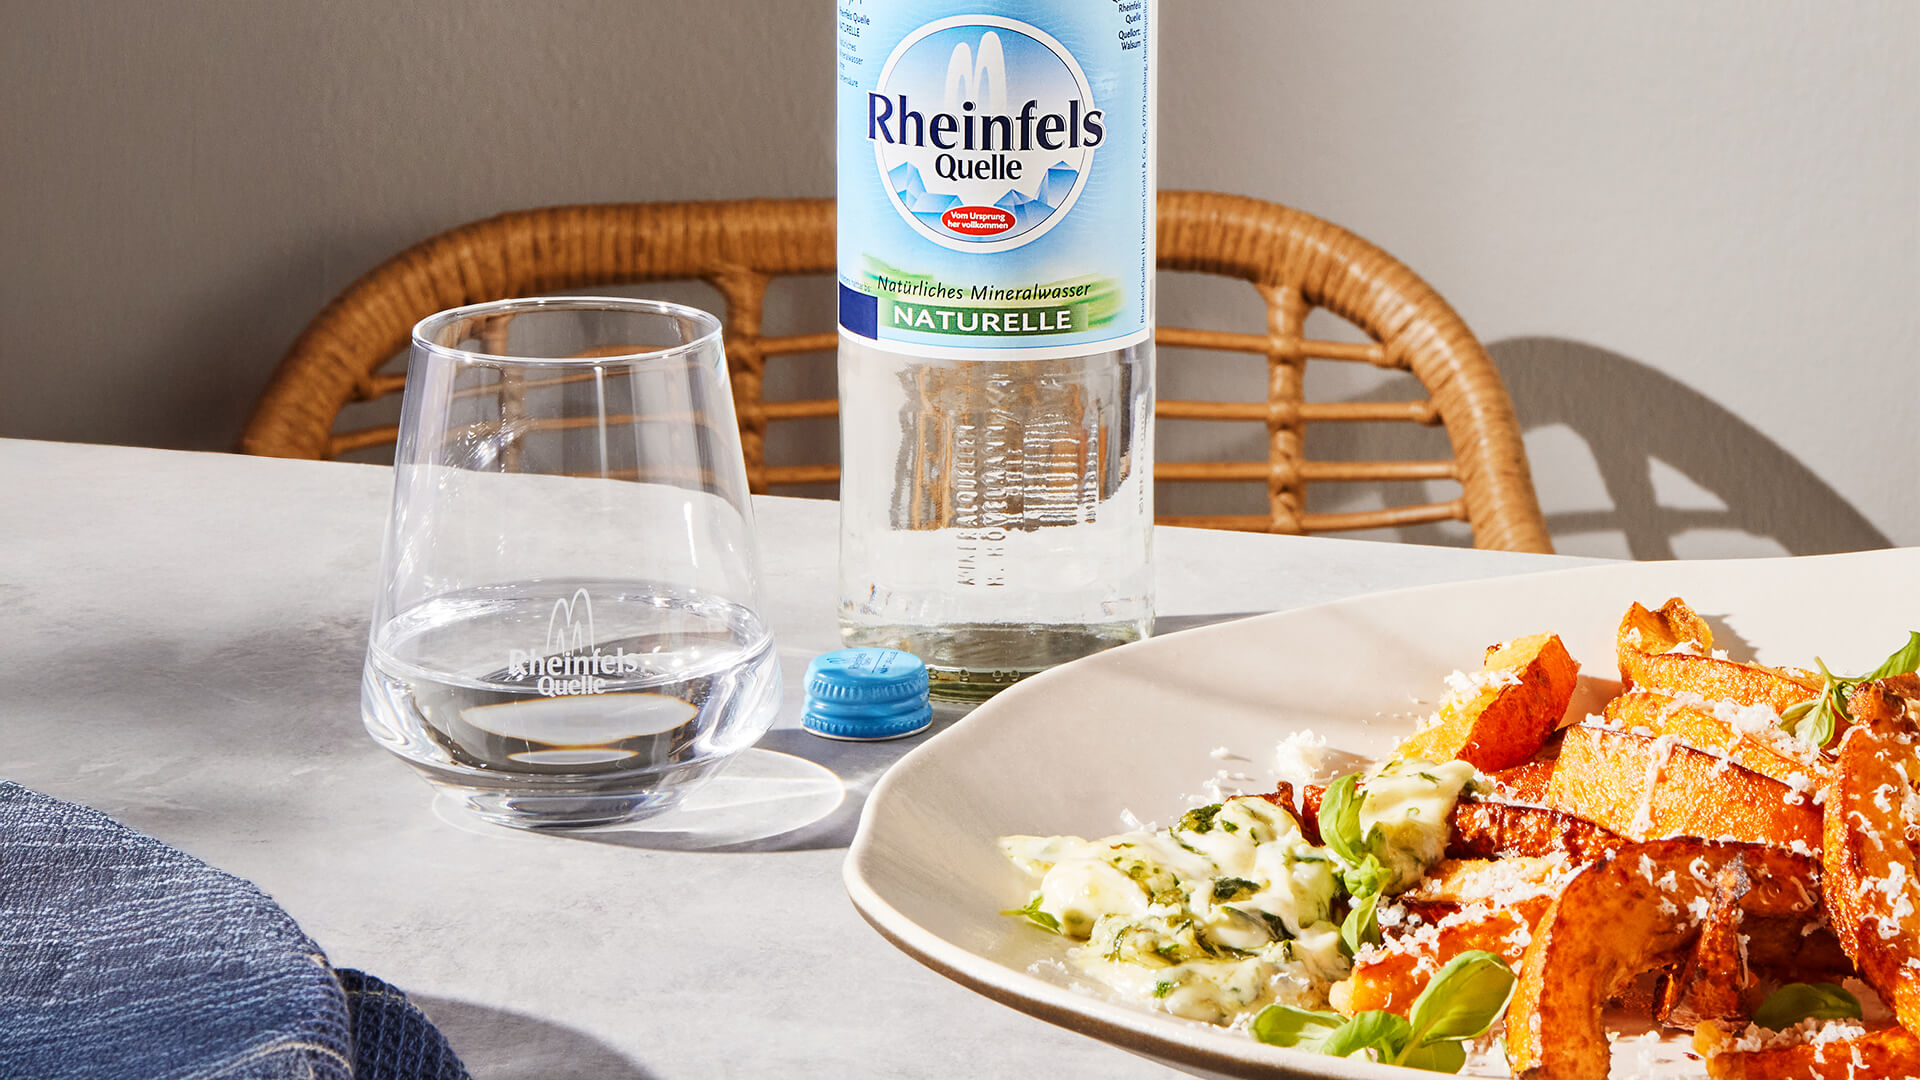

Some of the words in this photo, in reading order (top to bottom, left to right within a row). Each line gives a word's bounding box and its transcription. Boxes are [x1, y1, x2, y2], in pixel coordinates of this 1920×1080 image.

[1126, 12, 1141, 24] Quelle
[1121, 40, 1141, 50] Walsum
[868, 92, 1103, 151] Rheinfels
[935, 153, 1022, 181] Quelle
[947, 220, 960, 228] her
[961, 221, 1009, 229] vollkommen
[950, 211, 968, 220] Vom
[969, 212, 1006, 223] Ursprung
[877, 275, 963, 300] Natürliches
[970, 283, 1091, 301] Mineralwasser
[894, 305, 1072, 332] NATURELLE
[508, 647, 638, 676] Rheinfels
[537, 676, 607, 698] Quelle
